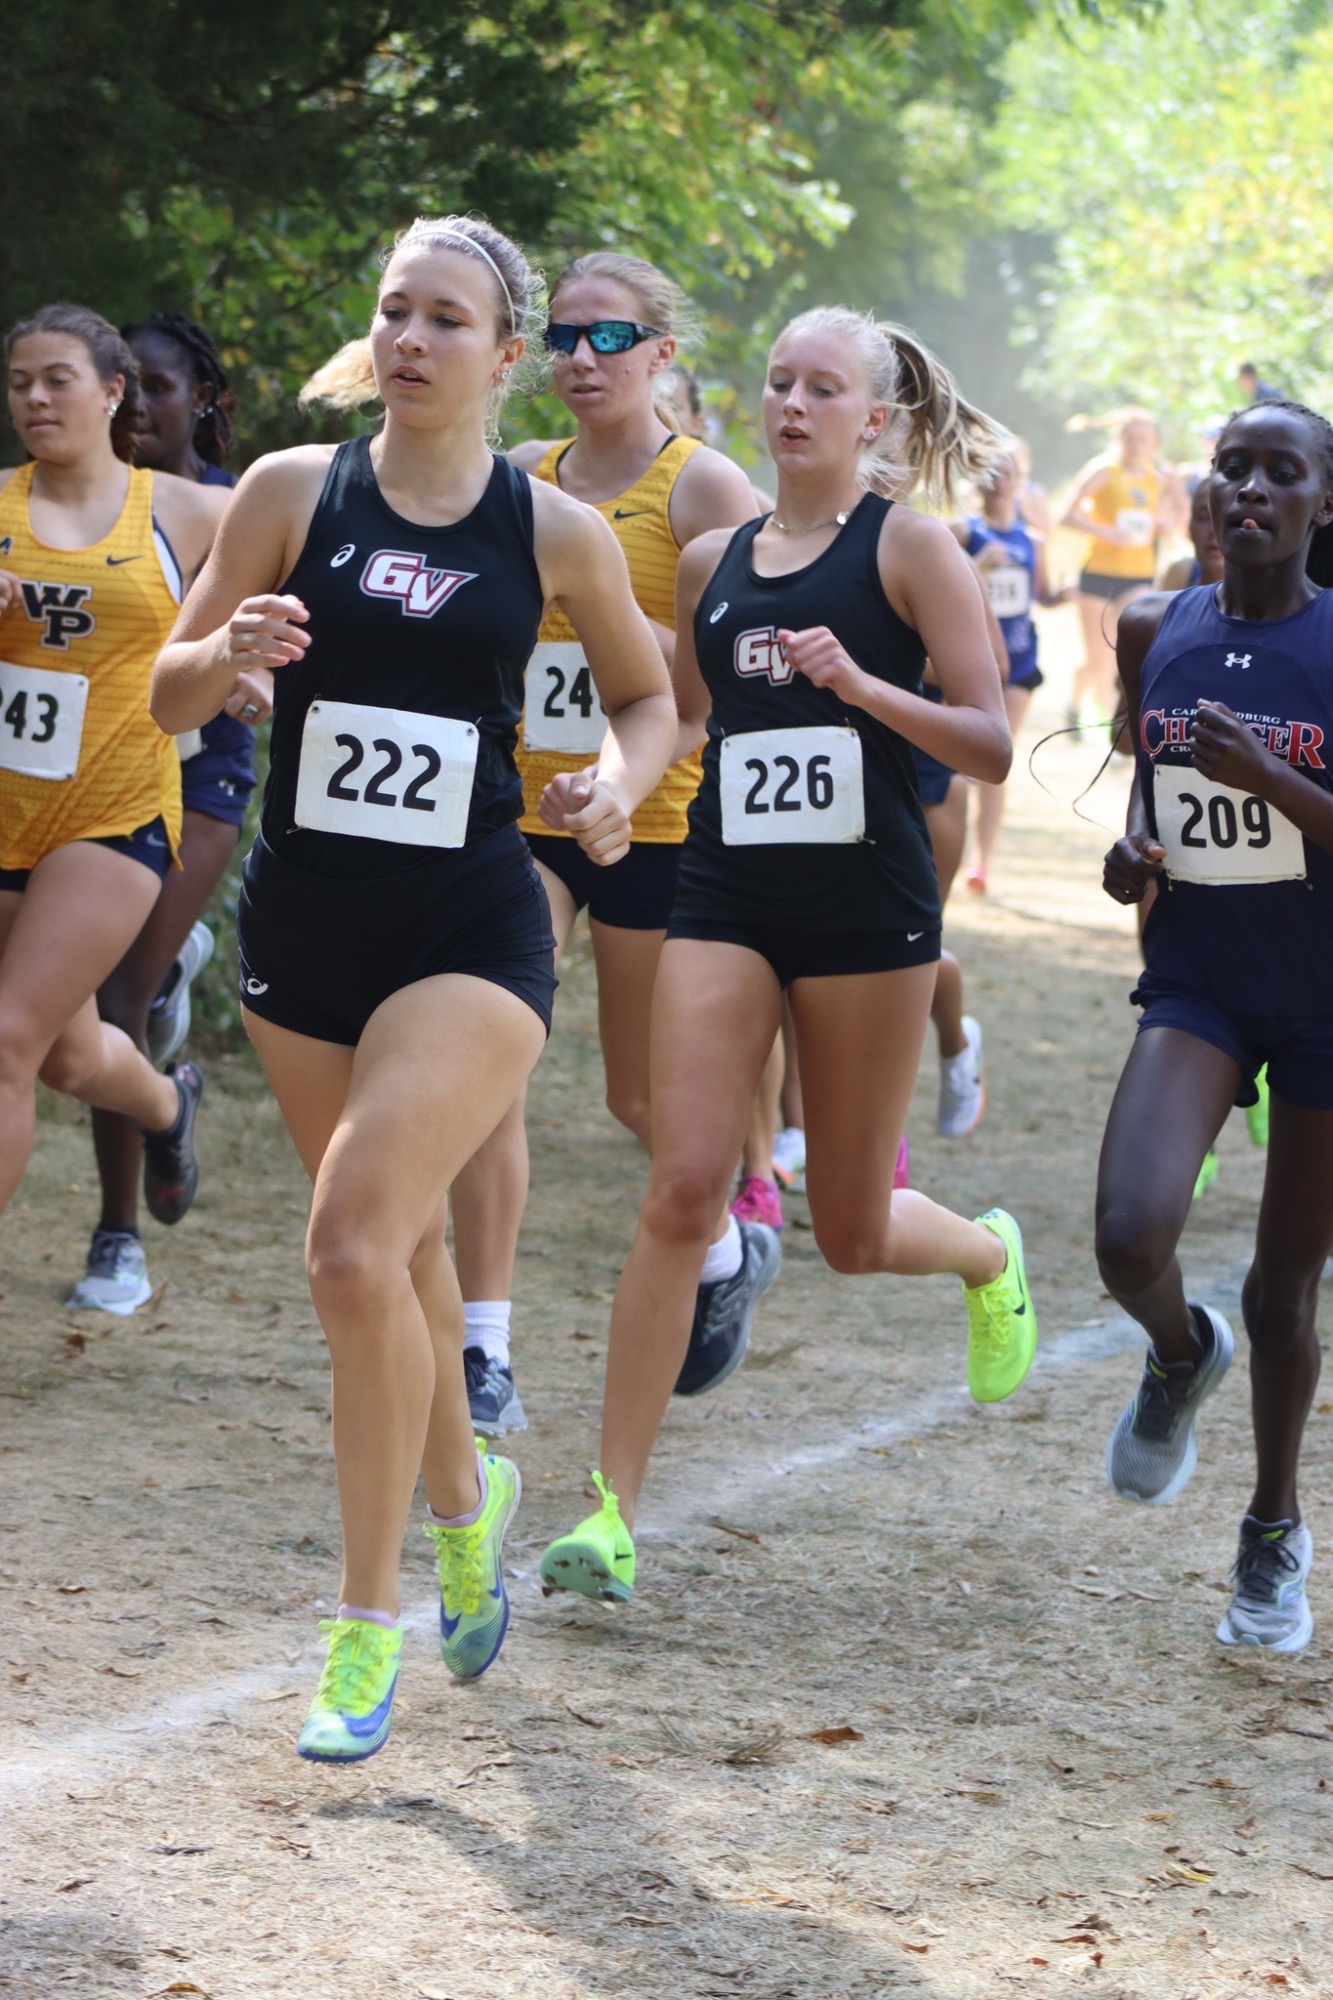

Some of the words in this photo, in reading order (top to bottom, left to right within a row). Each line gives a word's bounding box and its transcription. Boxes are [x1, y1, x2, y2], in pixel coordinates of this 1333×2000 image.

[359, 549, 480, 619] GV
[0, 687, 59, 743] 43
[544, 666, 609, 718] 24
[326, 733, 442, 812] 222
[744, 755, 834, 815] 226
[1177, 792, 1272, 849] 209
